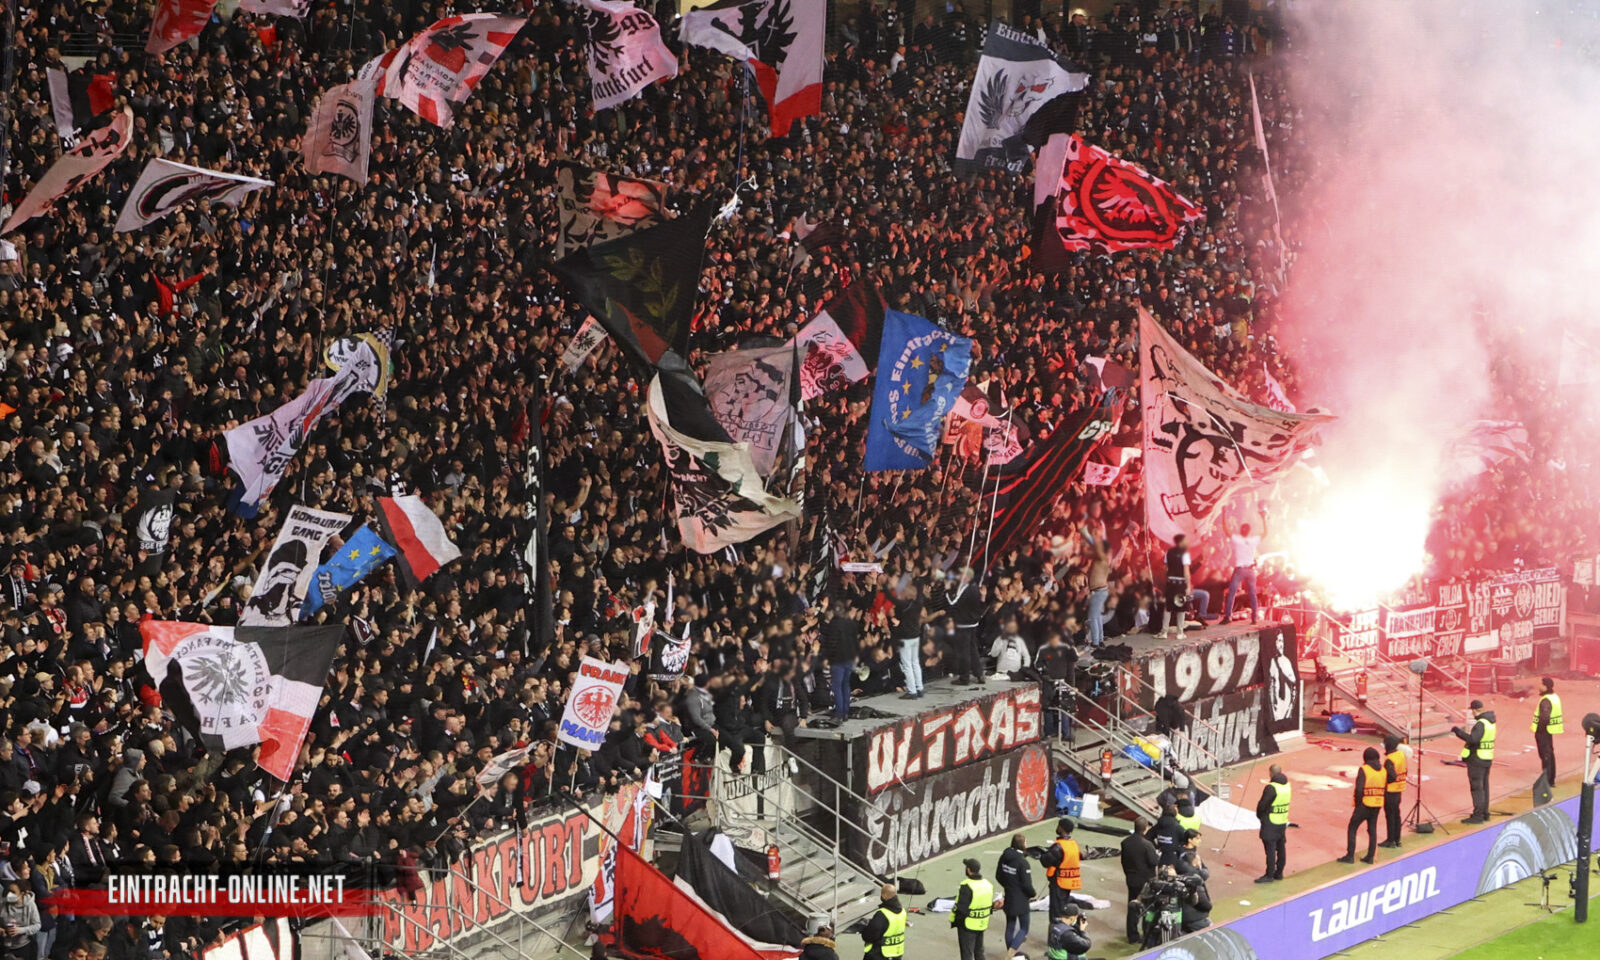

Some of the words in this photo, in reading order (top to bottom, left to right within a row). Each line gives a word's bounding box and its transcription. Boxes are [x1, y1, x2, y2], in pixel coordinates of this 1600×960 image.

[1149, 633, 1260, 709] 1997
[867, 687, 1041, 794] ULTRAS
[866, 758, 1010, 876] Eintracht
